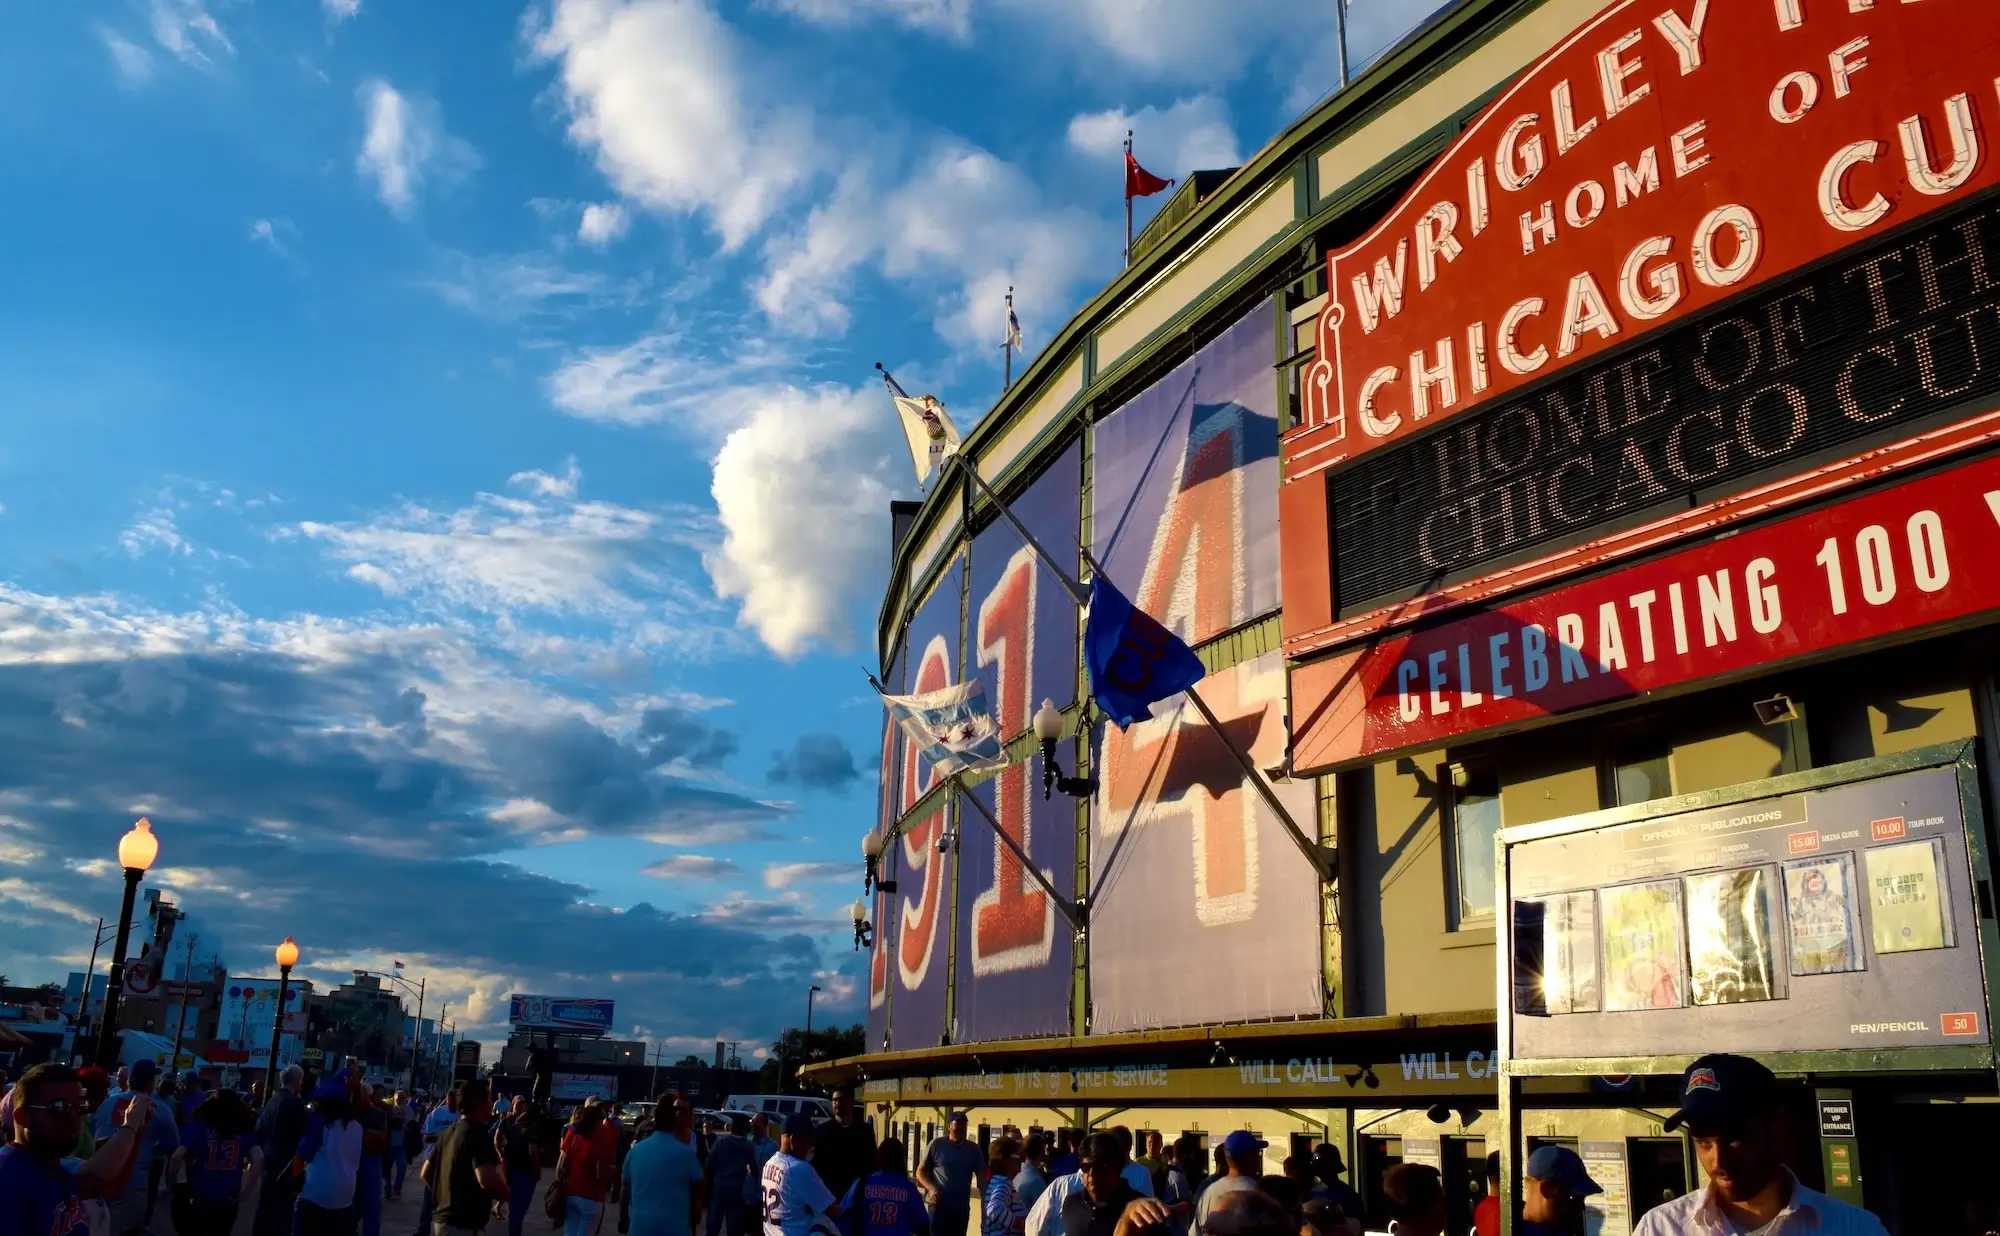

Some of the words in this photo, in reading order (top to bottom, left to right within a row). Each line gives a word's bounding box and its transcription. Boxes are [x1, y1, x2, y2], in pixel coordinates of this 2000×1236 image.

[1519, 118, 1715, 256] HOME
[1768, 35, 1870, 125] OF
[1352, 0, 1709, 335] WRIGLEY
[1358, 203, 1762, 438] CHICAGO
[1817, 77, 2000, 232] CU
[1430, 349, 1673, 498] HOME
[1697, 284, 1816, 392] OF
[1842, 208, 2000, 334] TH
[1417, 381, 1807, 571] CHICAGO
[1836, 300, 2000, 423] CU
[1398, 556, 1782, 724] CELEBRATING
[1815, 508, 1951, 617] 100
[1641, 827, 1688, 842] OFFICIAL
[1700, 810, 1783, 832] PUBLICATIONS
[1792, 836, 1816, 849] 15.00
[1821, 833, 1841, 843] MEDIA
[1841, 829, 1860, 840] GUIDE
[1875, 822, 1901, 836] 10.00
[1907, 819, 1925, 829] TOUR
[1926, 816, 1945, 825] BOOK
[1850, 1021, 1928, 1034] PEN/PENCIL
[1952, 1018, 1968, 1030] .50
[1111, 1063, 1168, 1086] SERVICE
[1239, 1059, 1281, 1084] WILL
[1286, 1056, 1341, 1083] CALL
[1399, 1051, 1459, 1081] WILL
[1822, 1106, 1848, 1114] PREMIER
[1831, 1114, 1842, 1122] VIP
[1646, 1123, 1662, 1138] 10
[1822, 1122, 1852, 1130] ENTRANCE
[204, 1139, 240, 1171] 13
[864, 1184, 909, 1202] CASTRO
[869, 1200, 899, 1226] 13
